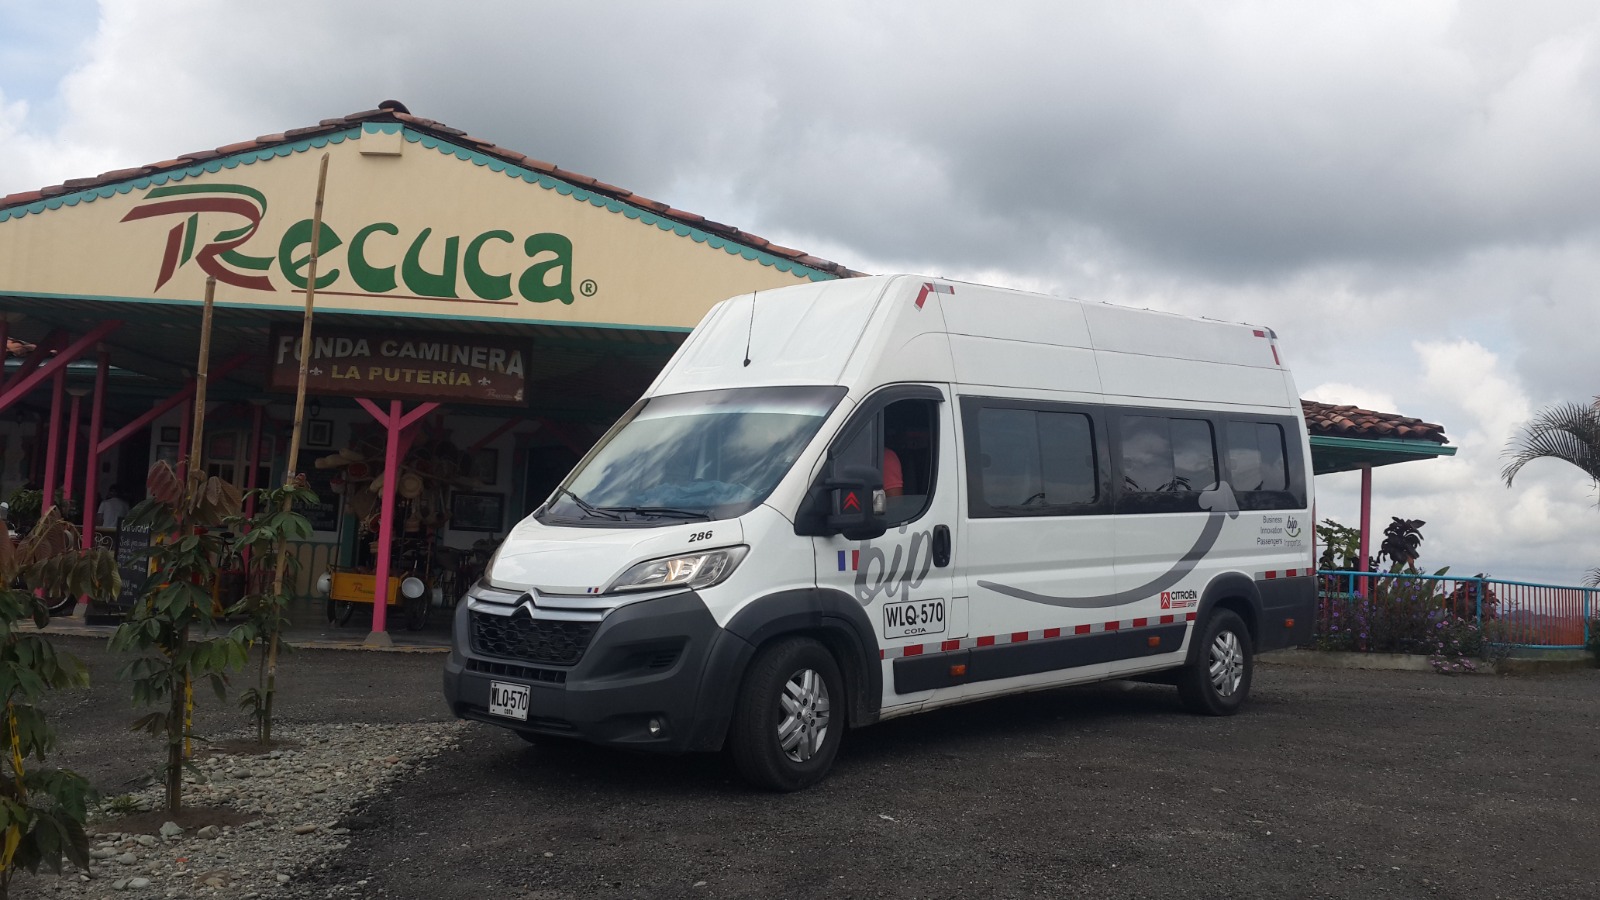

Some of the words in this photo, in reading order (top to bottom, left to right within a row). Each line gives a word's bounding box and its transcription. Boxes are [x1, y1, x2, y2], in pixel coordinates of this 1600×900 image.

[119, 184, 575, 305] Recuca
[277, 336, 371, 364] FONDA
[380, 340, 525, 380] CAMINERA
[331, 365, 361, 380] LA
[368, 366, 472, 387] PUTERÍA
[1262, 515, 1282, 523] Business
[688, 530, 714, 543] 286
[1257, 537, 1282, 546] Passengers
